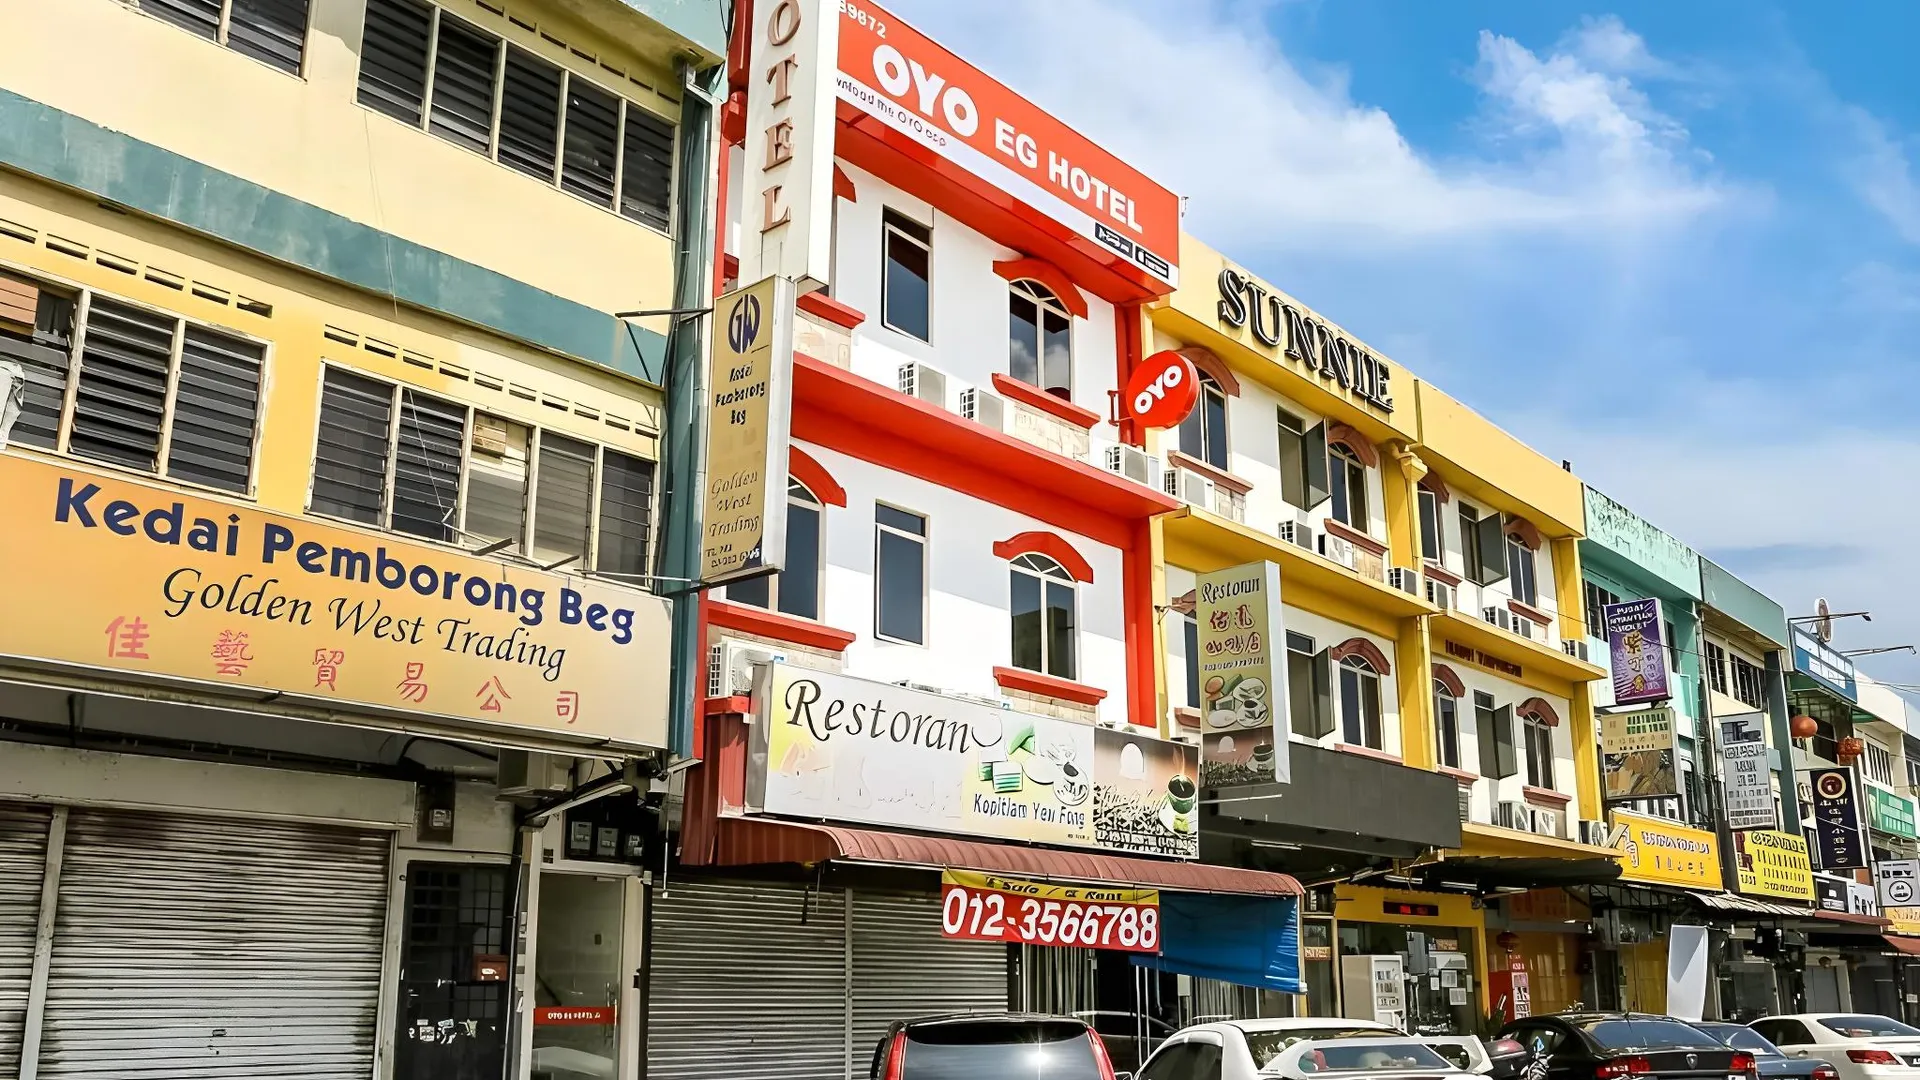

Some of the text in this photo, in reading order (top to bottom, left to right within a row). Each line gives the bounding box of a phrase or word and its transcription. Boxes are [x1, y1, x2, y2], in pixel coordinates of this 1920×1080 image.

[872, 44, 1143, 234] OYO EG HOTEL
[1134, 365, 1182, 415] OYO
[1217, 269, 1394, 413] SUNNIE
[55, 477, 636, 645] Kedai Pemborong Beg
[104, 616, 579, 724] 佳藝貿易公司
[163, 567, 566, 682] Golden West Trading
[785, 679, 990, 754] Restoran
[943, 888, 1158, 949] 012-3566788
